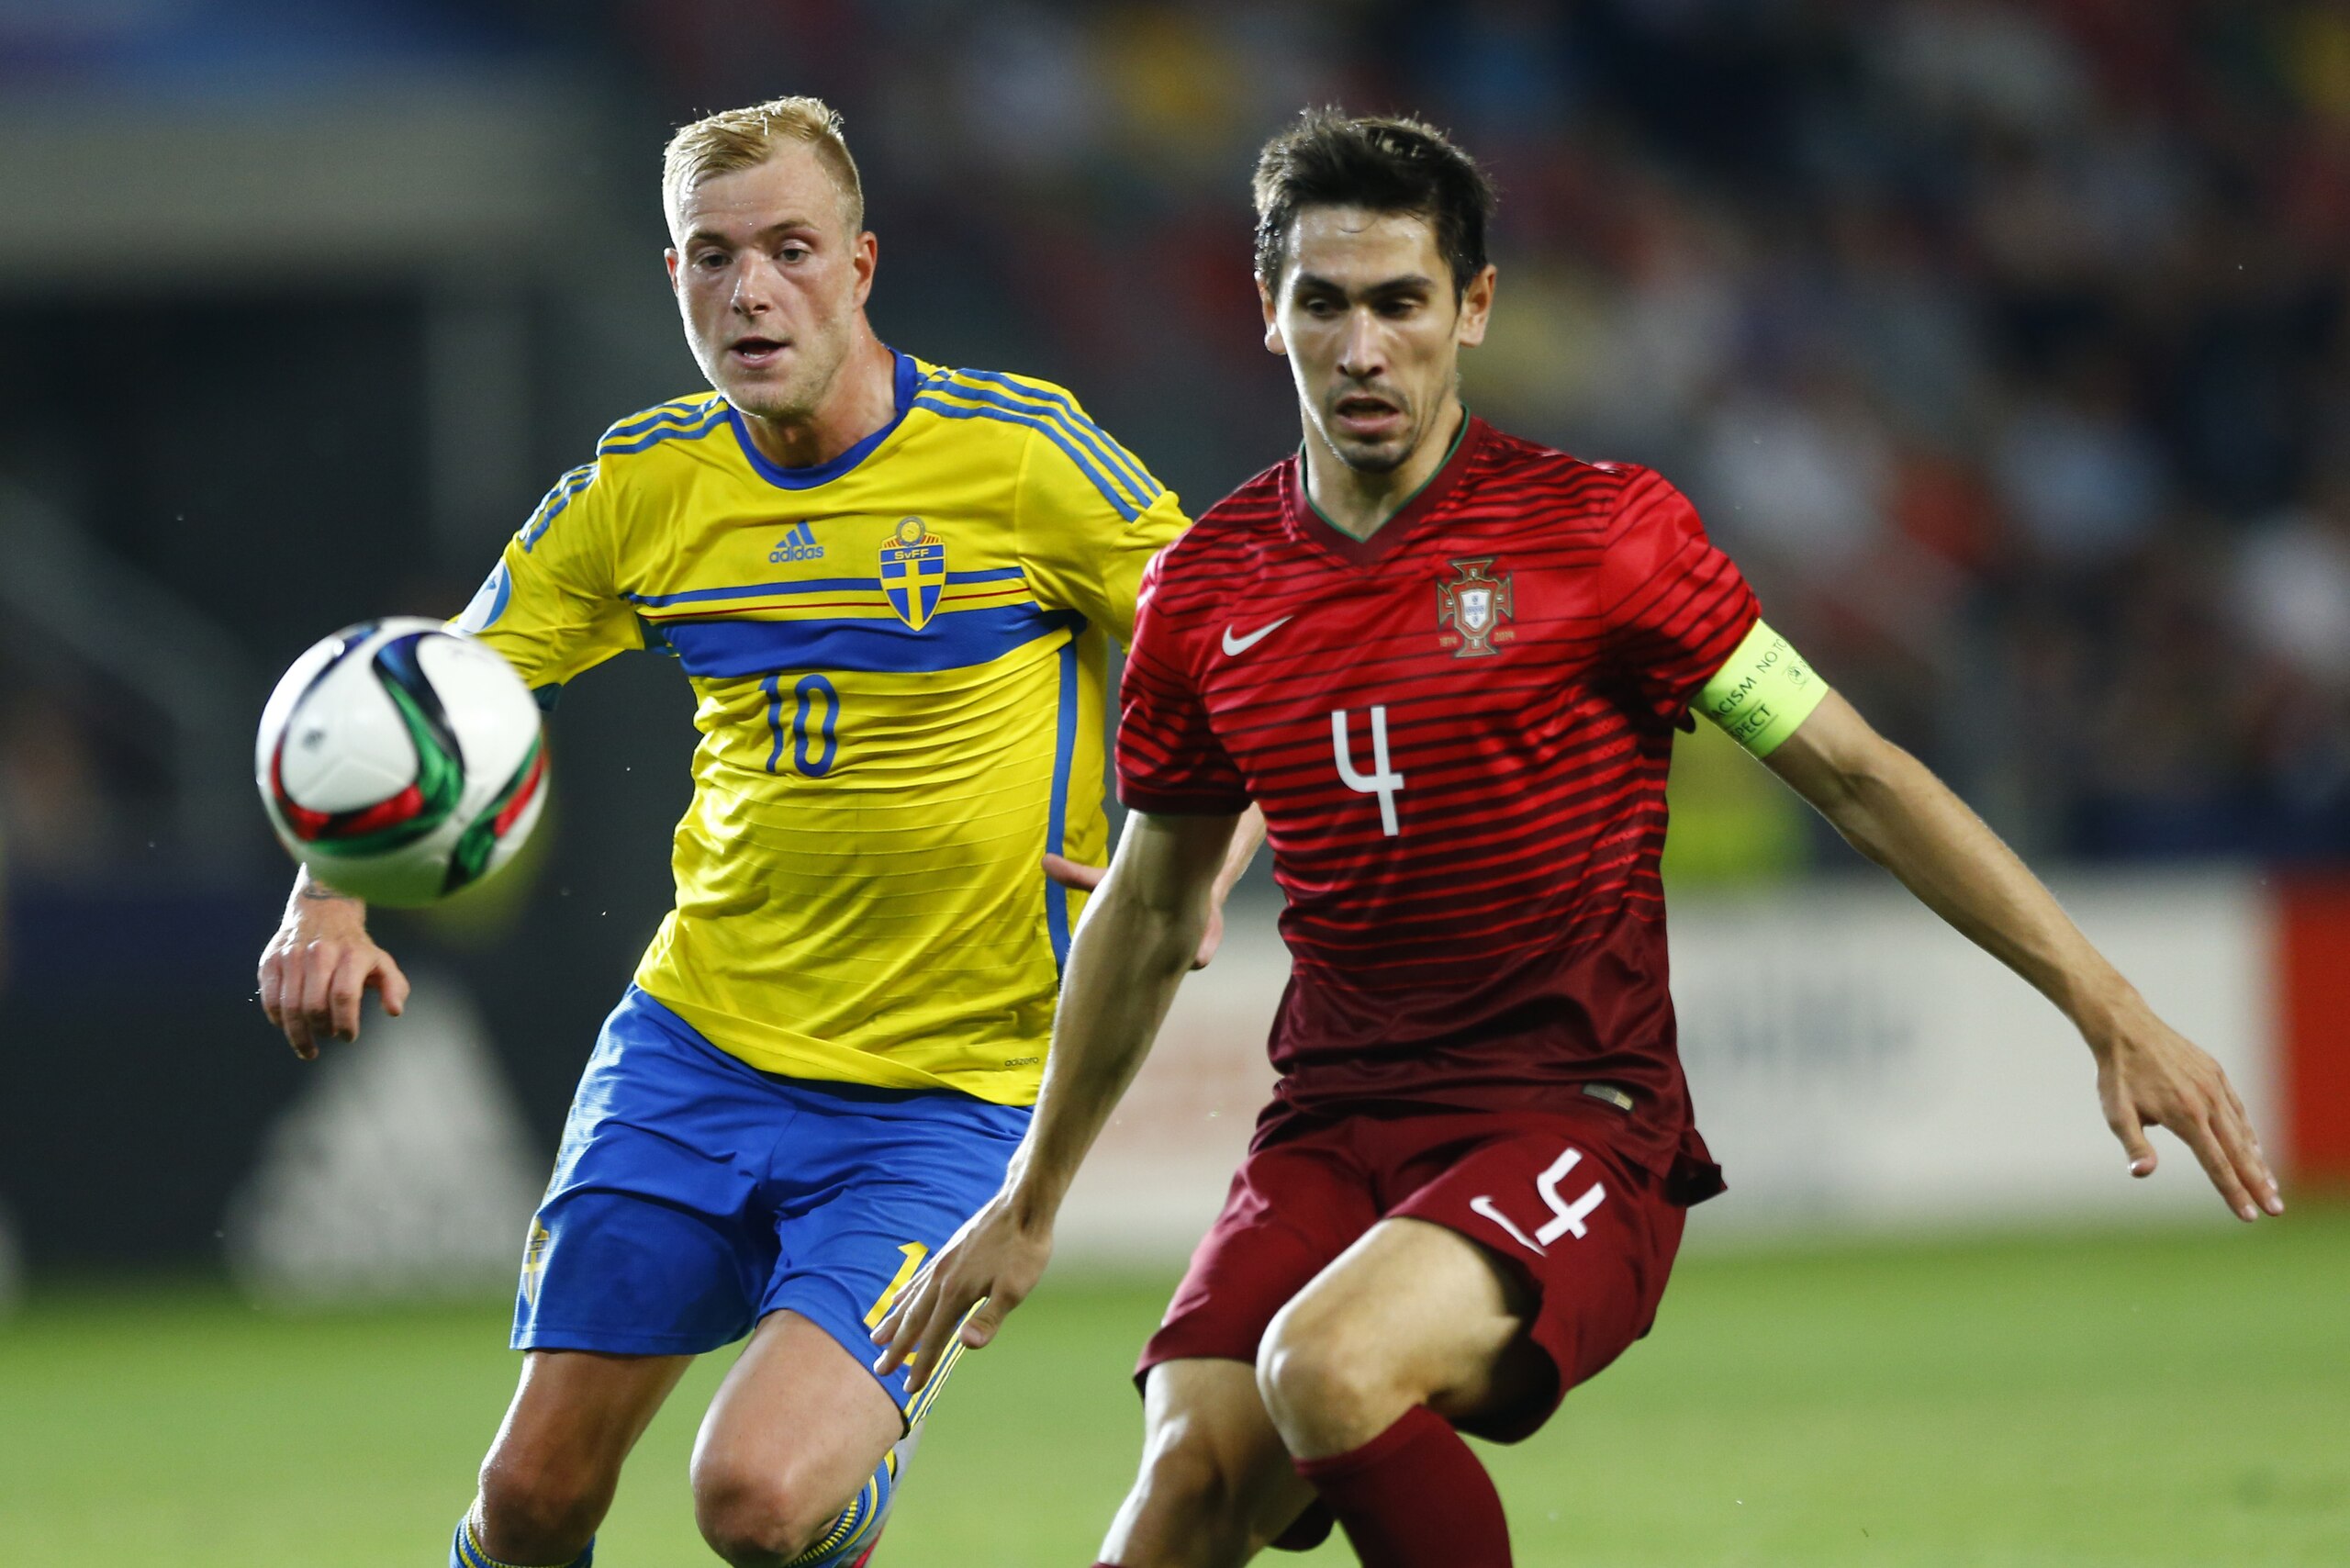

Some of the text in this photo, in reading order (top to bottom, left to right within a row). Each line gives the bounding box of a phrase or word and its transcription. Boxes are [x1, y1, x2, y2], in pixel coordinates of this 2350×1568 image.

[769, 544, 824, 563] adidas
[894, 549, 930, 560] SvFF
[757, 672, 840, 778] 10
[1710, 677, 1757, 718] ACISM
[1755, 650, 1778, 673] NO
[1331, 705, 1404, 836] 4
[1534, 1147, 1606, 1247] 4
